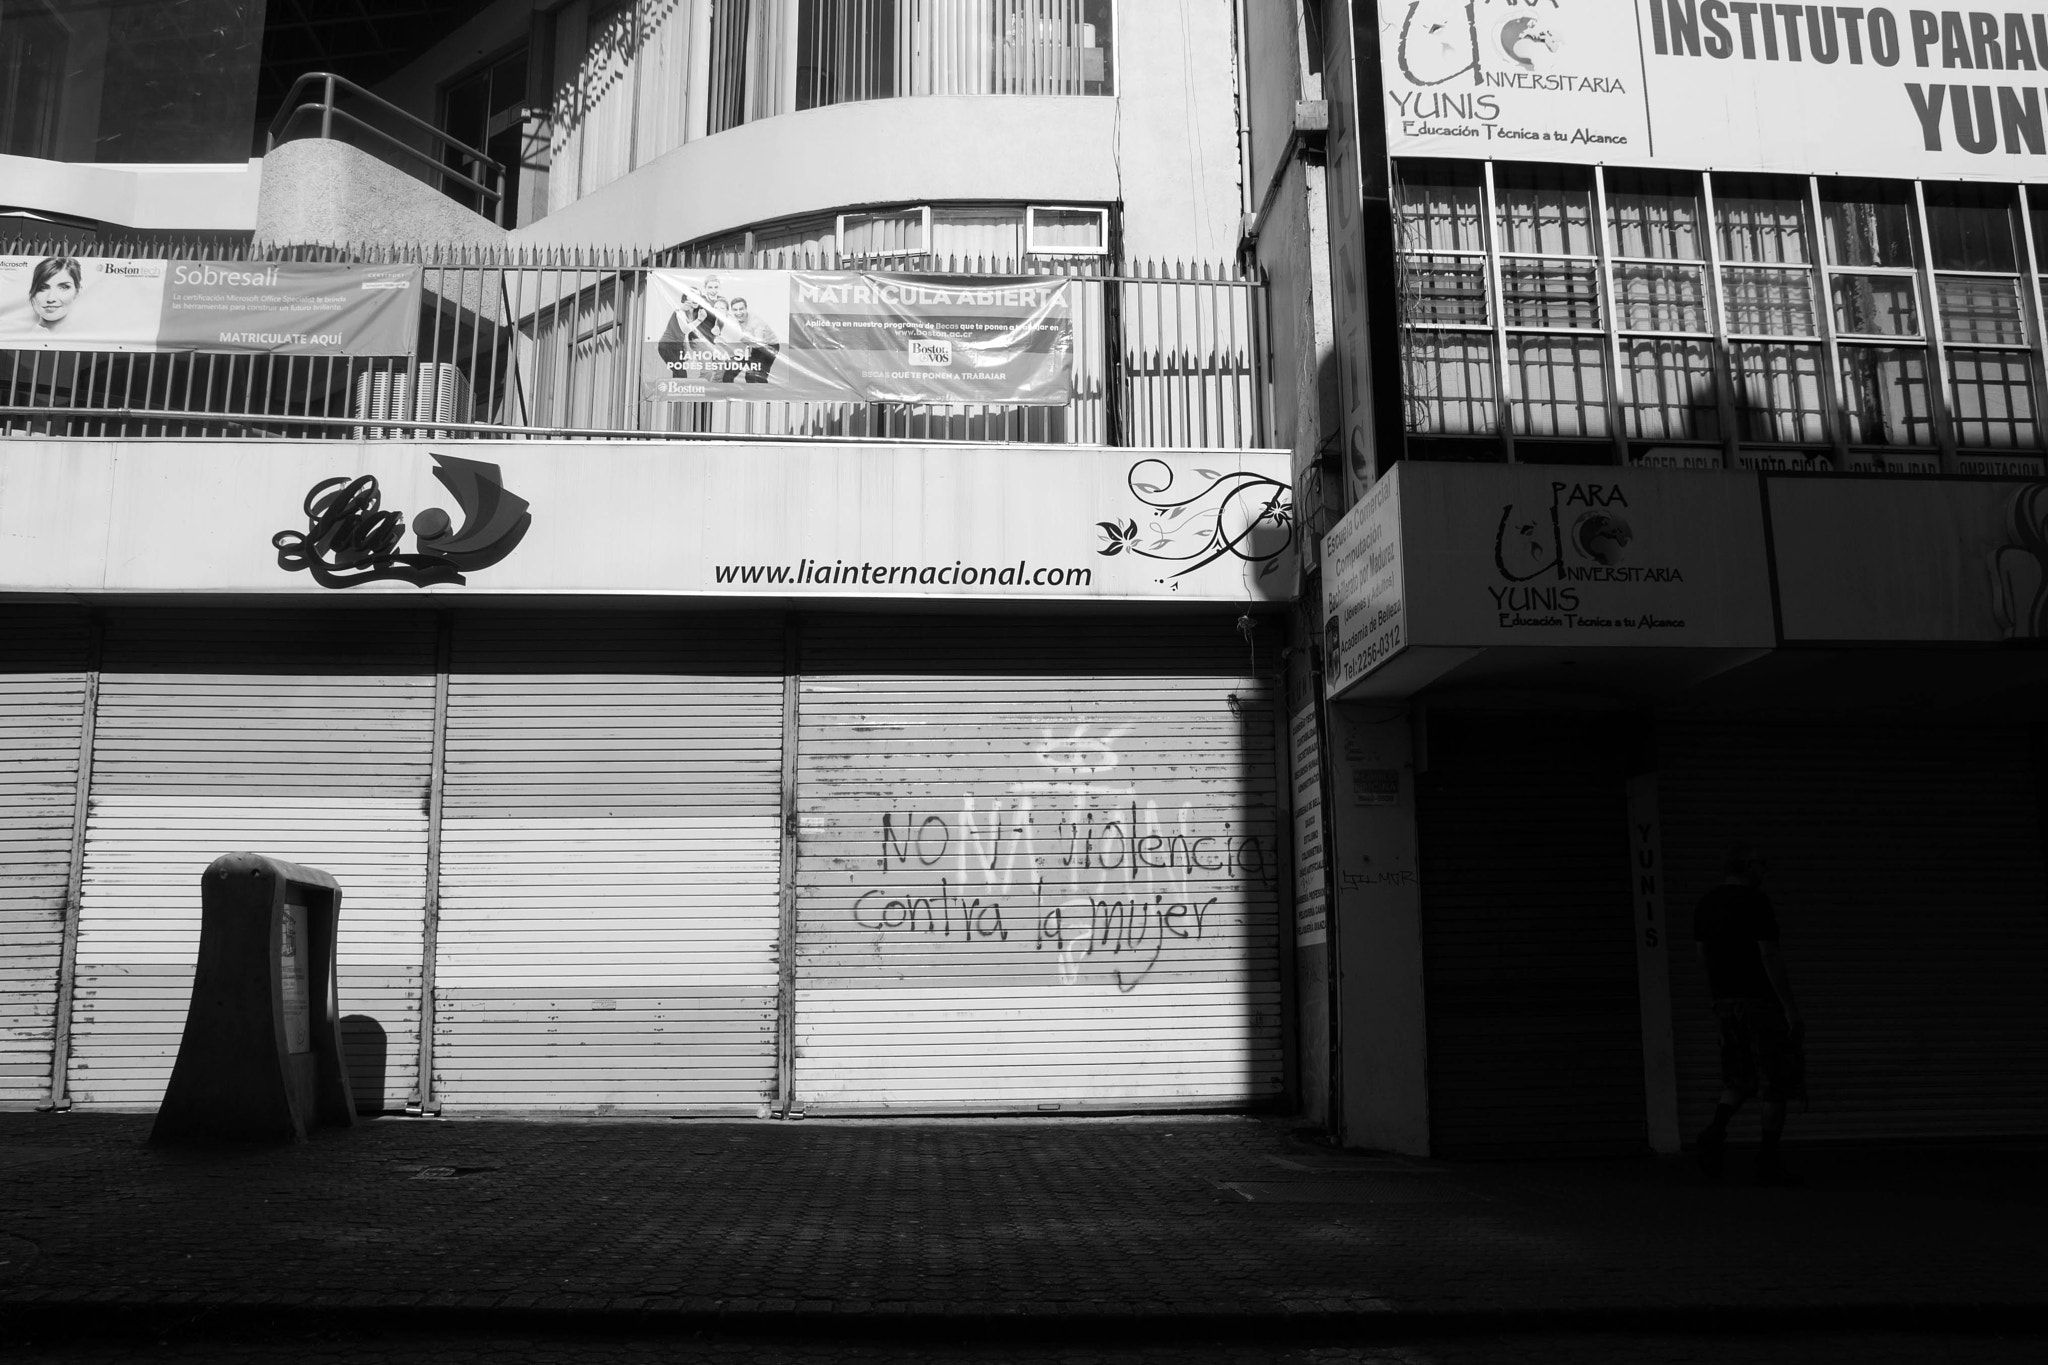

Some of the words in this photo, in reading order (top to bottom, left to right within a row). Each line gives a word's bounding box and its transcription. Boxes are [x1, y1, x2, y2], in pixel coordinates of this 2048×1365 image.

[1650, 0, 1900, 67] INSTITUTO
[1389, 90, 1500, 120] YUNIS
[1402, 121, 1480, 138] Educación
[1481, 123, 1540, 141] Técnica
[1542, 132, 1551, 141] a
[1554, 130, 1568, 142] tu
[1570, 128, 1628, 144] Alcance
[173, 266, 279, 287] Sobresalí
[230, 304, 246, 313] para
[957, 286, 1068, 308] ABIERTA
[831, 322, 841, 330] ya
[924, 322, 934, 330] de
[960, 323, 975, 331] que
[975, 323, 983, 331] te
[984, 324, 1008, 332] ponen
[219, 332, 307, 345] MATRICULATE
[309, 332, 343, 347] AQUÍ
[705, 362, 761, 371] ESTUDIAR!
[891, 371, 909, 379] QUE
[668, 381, 705, 393] Boston
[1327, 518, 1353, 557] Escuela
[1354, 475, 1391, 530] Comercial
[1336, 523, 1383, 577] Computación
[715, 559, 1092, 586] www.liainternacional.com
[1488, 586, 1580, 611] YUNIS
[1341, 623, 1368, 656] Academia
[1369, 616, 1377, 633] de
[1377, 599, 1402, 627] Belleza
[1499, 613, 1563, 628] Educación
[1564, 614, 1613, 628] Técnica
[1614, 618, 1623, 628] a
[1624, 617, 1636, 628] tu
[1638, 615, 1685, 629] Alcance
[1344, 624, 1401, 682] Tel:2256-0312
[880, 812, 949, 873] NO
[1637, 823, 1659, 947] YUNIS
